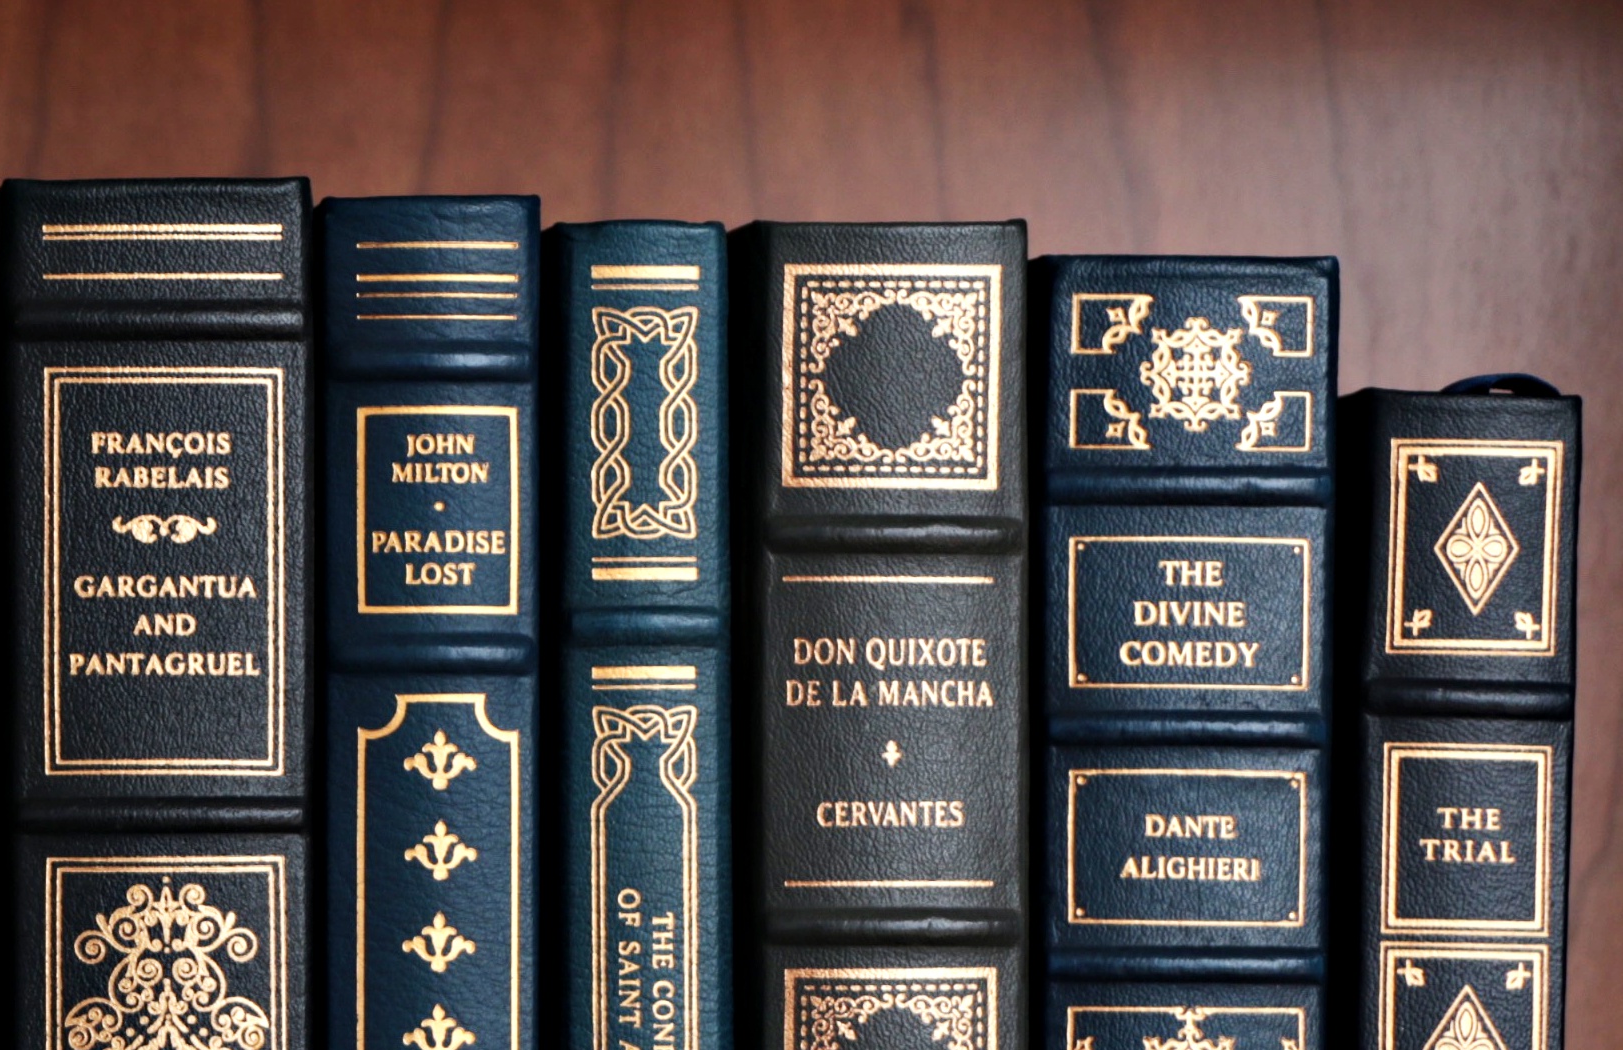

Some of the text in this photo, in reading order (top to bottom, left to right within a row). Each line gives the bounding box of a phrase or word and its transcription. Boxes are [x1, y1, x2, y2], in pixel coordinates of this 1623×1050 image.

[91, 431, 232, 459] FRANÇOIS
[406, 433, 476, 457] JOHN
[94, 465, 232, 490] RABELAIS
[391, 461, 490, 485] MILTON
[371, 529, 507, 555] PARADISE
[73, 573, 258, 599] GARGANTUA
[405, 561, 477, 586] LOST
[1158, 559, 1225, 588] THE
[133, 612, 198, 637] AND
[1133, 600, 1247, 629] DIVINE
[69, 651, 262, 677] PANTAGRUEL
[793, 636, 988, 671] DON QUIXOTE
[1119, 640, 1261, 669] COMEDY
[785, 679, 994, 708] DE LA MANCHA
[816, 800, 966, 829] CERVANTES
[1144, 813, 1239, 840] DANTE
[1436, 806, 1502, 832] THE
[1419, 838, 1517, 865] TRIAL
[1120, 855, 1262, 882] ALIGHIERI
[617, 887, 643, 928] OF
[651, 911, 677, 970] THE
[618, 940, 643, 1029] SAINT
